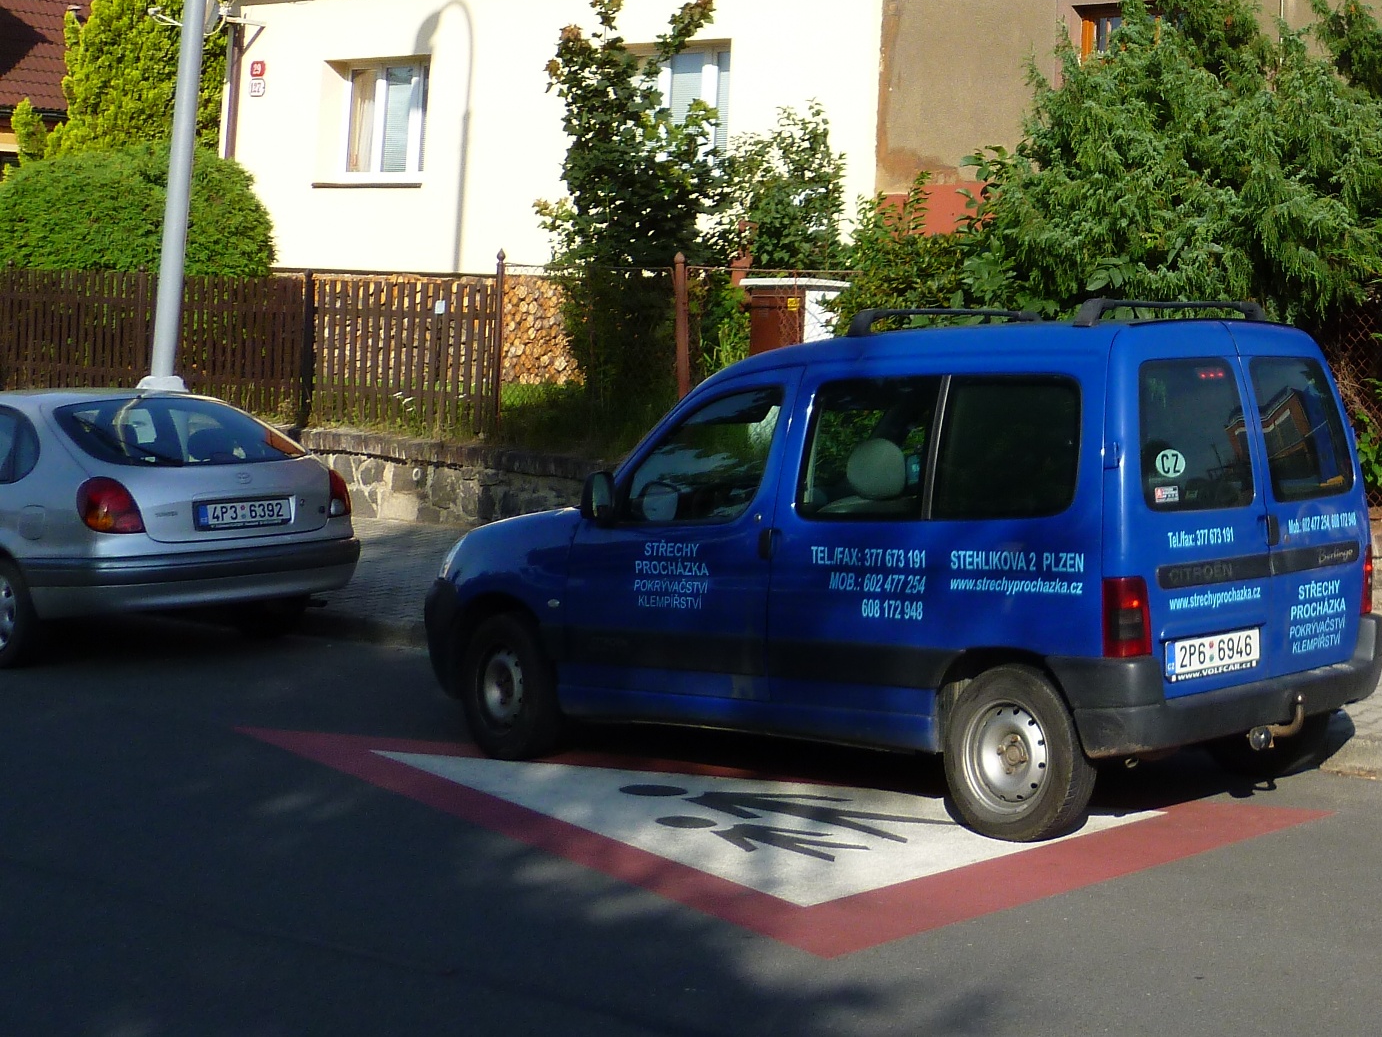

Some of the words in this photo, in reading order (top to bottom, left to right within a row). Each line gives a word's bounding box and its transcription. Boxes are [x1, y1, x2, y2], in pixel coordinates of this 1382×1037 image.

[1161, 453, 1181, 474] CZ
[212, 504, 238, 522] 4P3
[249, 502, 284, 518] 6392
[1196, 529, 1208, 545] 377
[1209, 527, 1221, 544] 673
[1222, 526, 1234, 543] 191
[644, 539, 700, 557] STŘECHY
[1318, 548, 1354, 565] Berlingo
[635, 558, 709, 576] PROCHÁZKA
[864, 549, 883, 567] 377
[885, 549, 905, 568] 673
[907, 549, 926, 569] 191
[950, 550, 1027, 571] STEHLIKOVA
[1028, 552, 1036, 571] 2
[1042, 553, 1085, 573] PLZEN
[829, 572, 861, 591] MOB.:
[863, 573, 883, 592] 602
[884, 574, 905, 593] 477
[905, 575, 926, 594] 254
[950, 576, 1083, 595] www.strechyprochazka.cz
[1298, 579, 1341, 600] STŘECHY
[1169, 585, 1261, 611] www.strechyprochazka.cz
[861, 599, 880, 618] 608
[883, 599, 902, 619] 172
[904, 600, 923, 620] 948
[1290, 597, 1347, 621] PROCHÁZKA
[1179, 642, 1206, 669] 2P6
[1217, 634, 1252, 661] 6946
